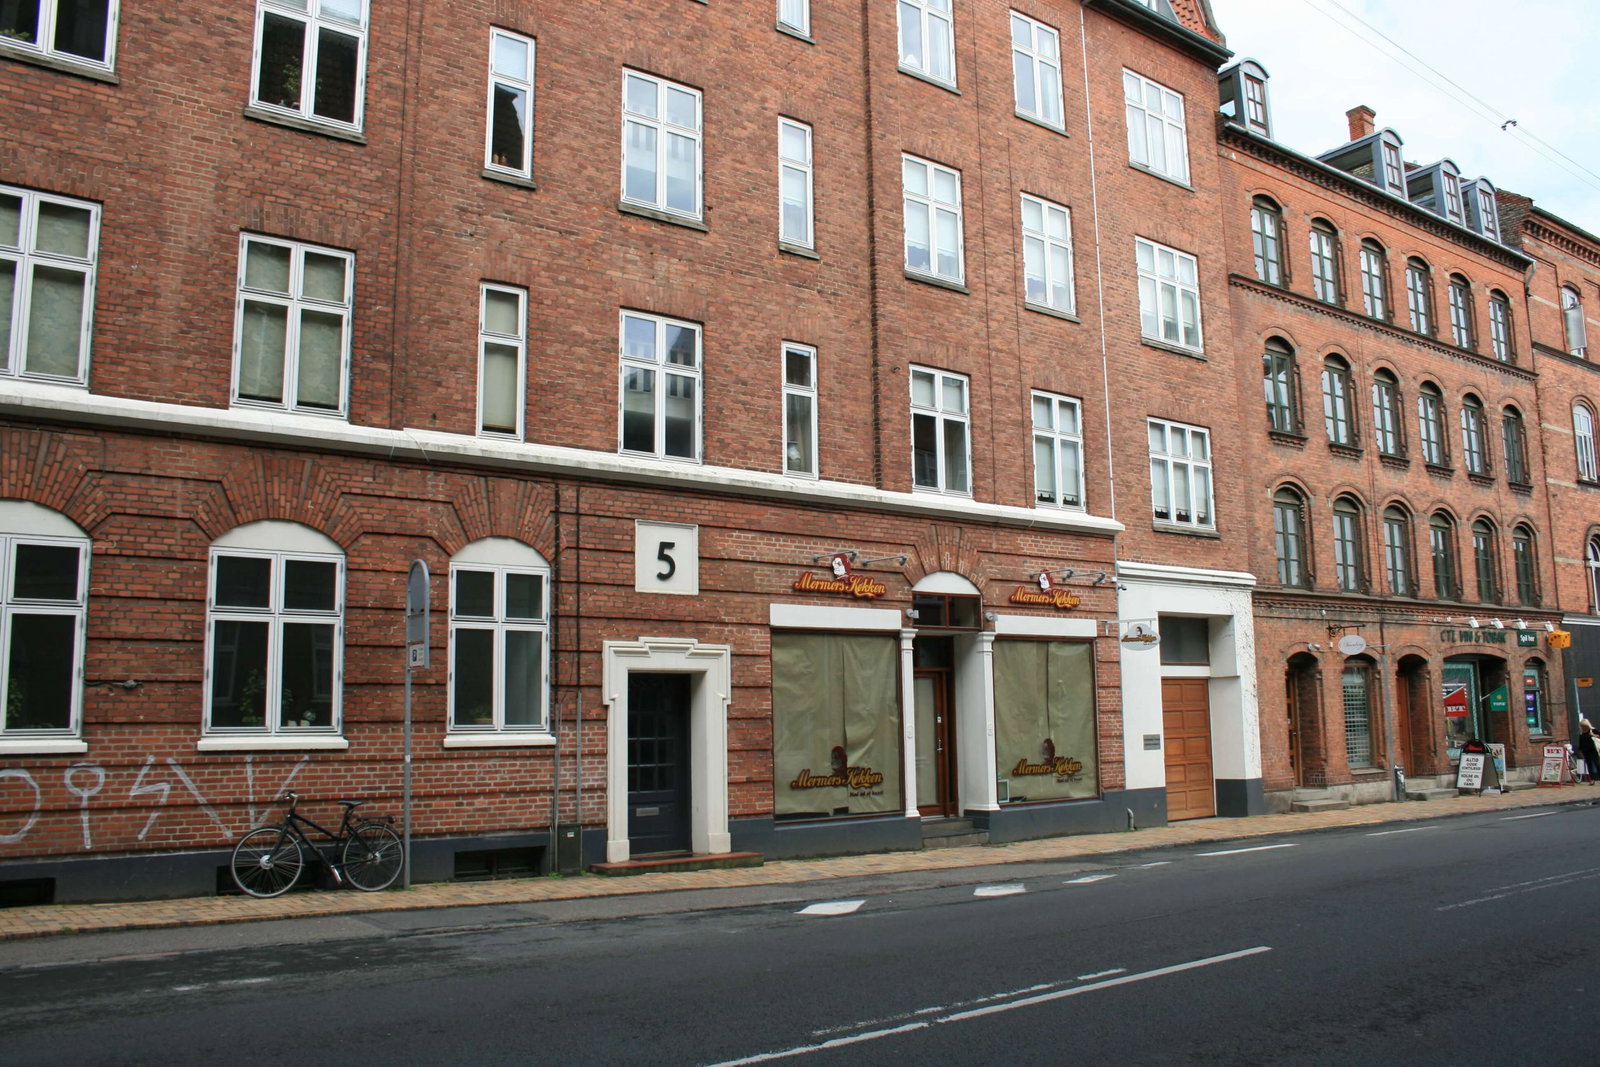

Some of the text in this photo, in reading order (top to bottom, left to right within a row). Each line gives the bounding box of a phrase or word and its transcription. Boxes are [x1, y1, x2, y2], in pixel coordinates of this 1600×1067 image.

[656, 541, 676, 582] 5
[794, 572, 845, 592] Mormors
[1010, 586, 1050, 604] Mormors
[1012, 758, 1051, 777] Mormors
[790, 768, 842, 790] Mormors
